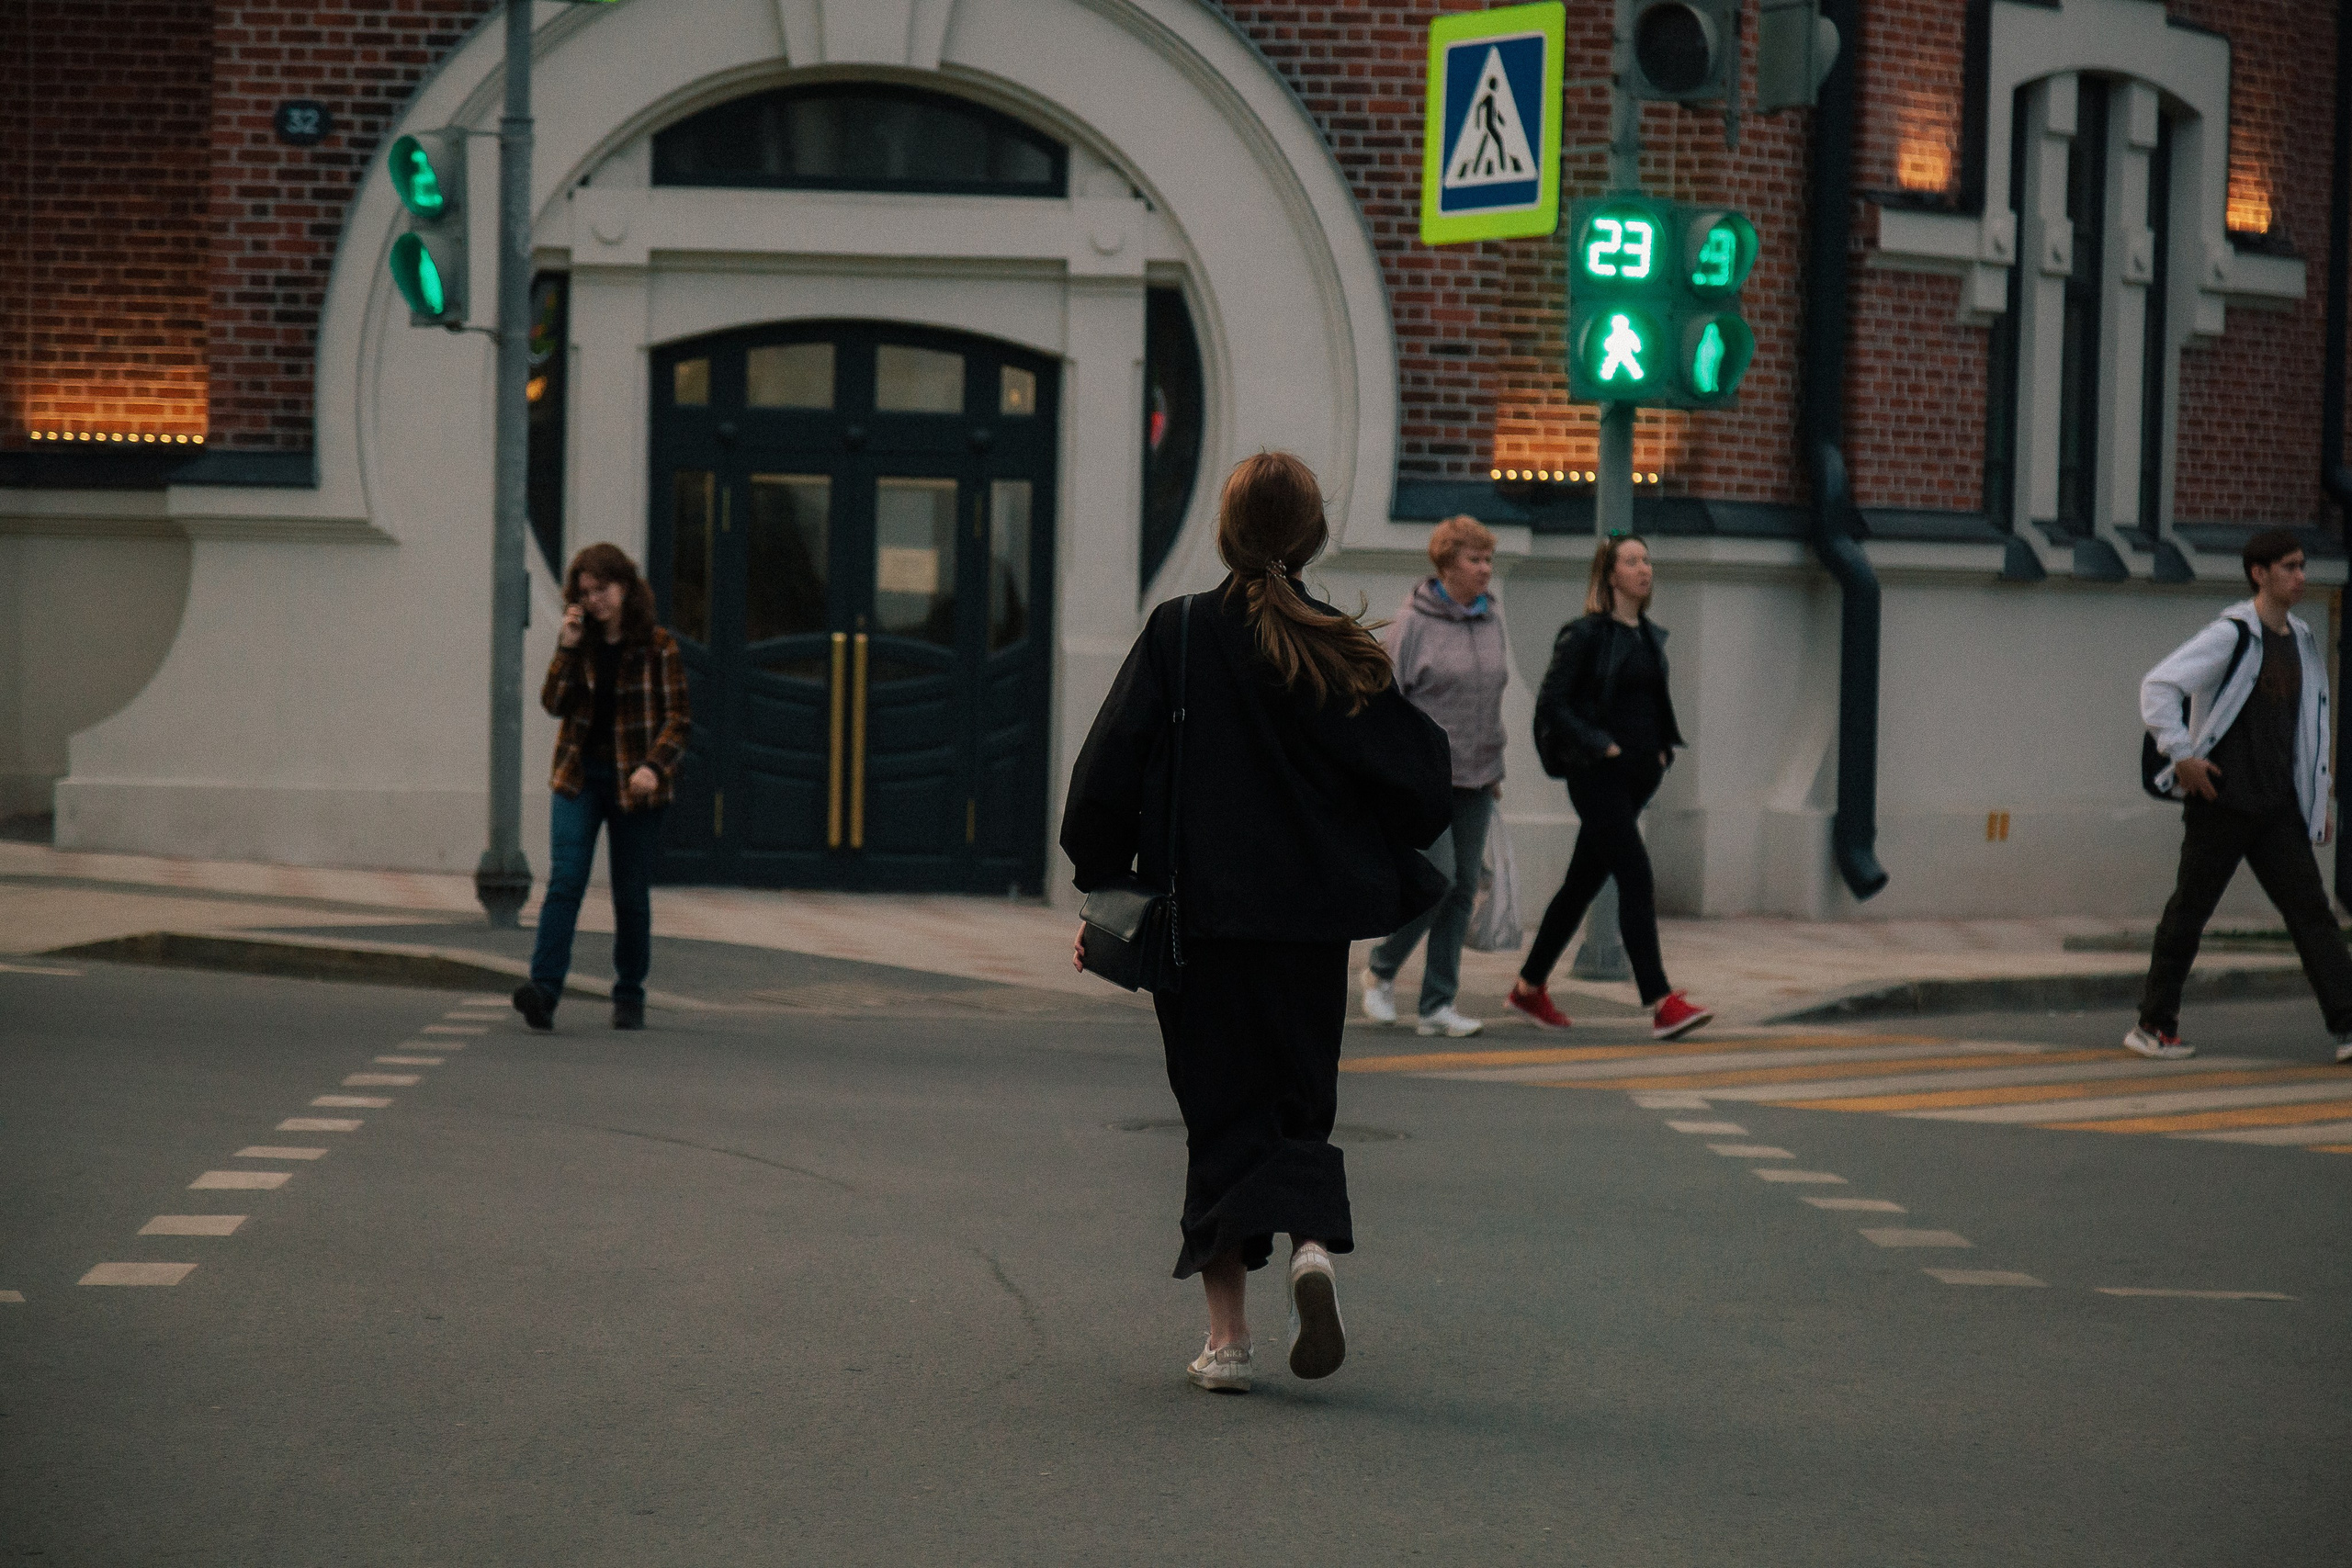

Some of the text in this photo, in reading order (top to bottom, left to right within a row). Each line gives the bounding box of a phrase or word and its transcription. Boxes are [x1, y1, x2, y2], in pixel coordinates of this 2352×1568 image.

[287, 108, 320, 134] 32
[1589, 219, 1653, 278] 23
[1223, 1348, 1244, 1358] NIKE
